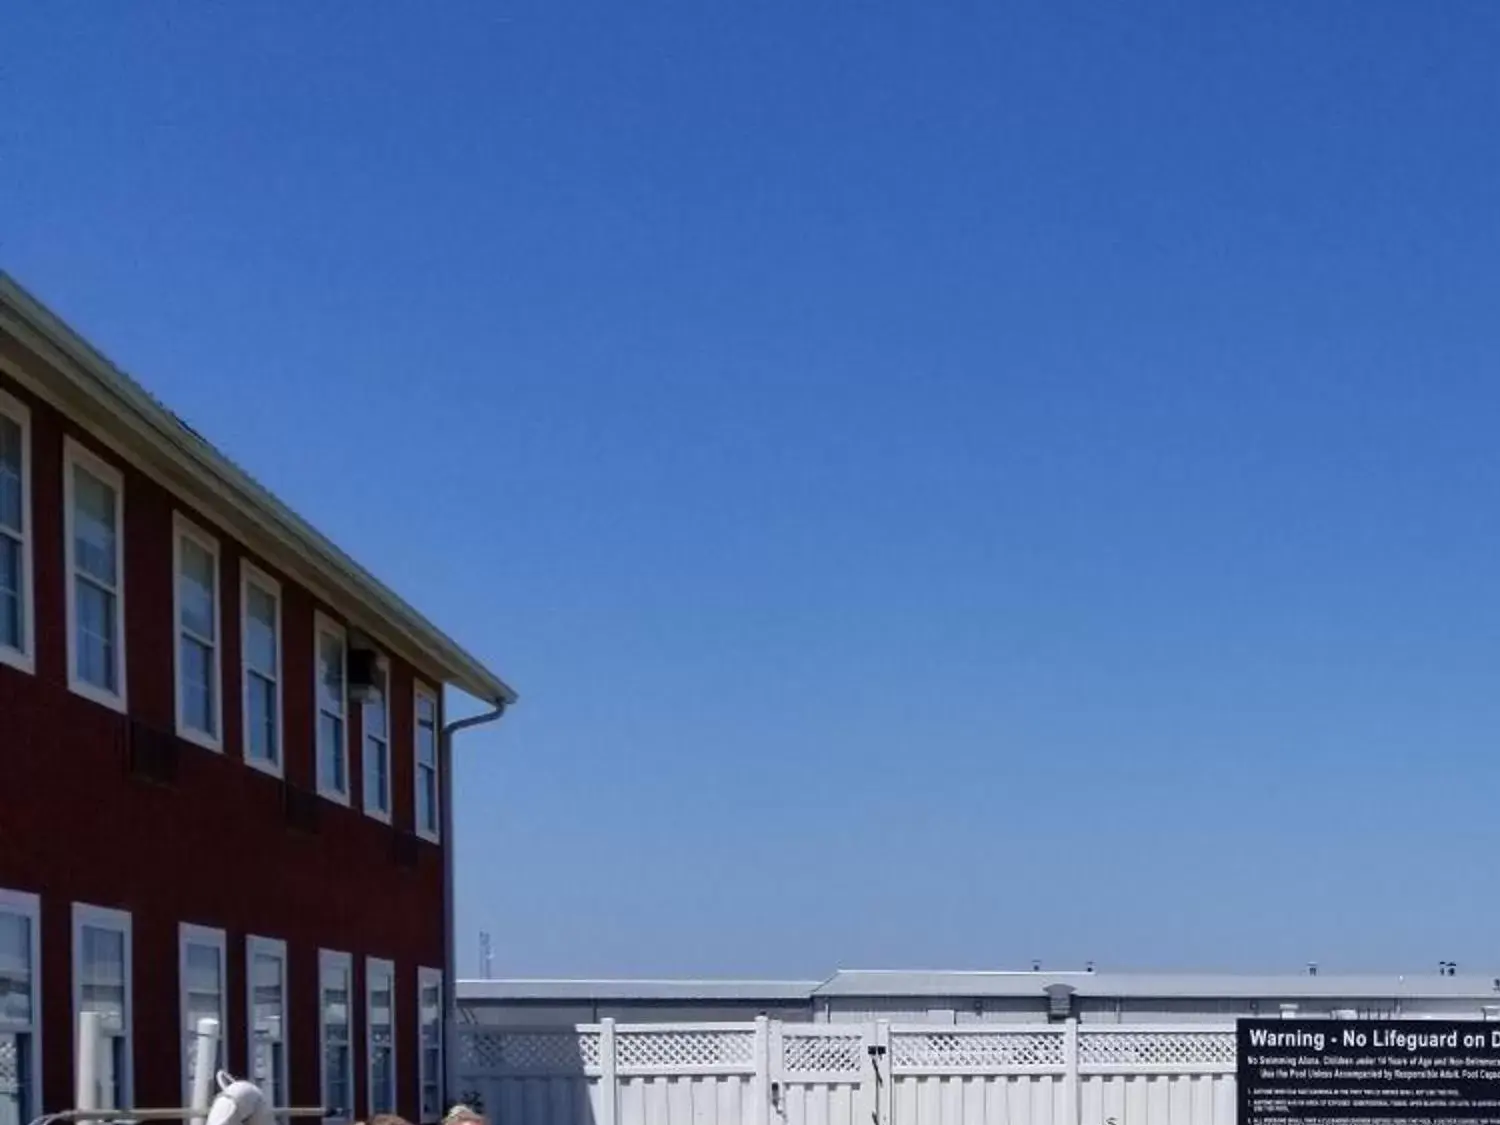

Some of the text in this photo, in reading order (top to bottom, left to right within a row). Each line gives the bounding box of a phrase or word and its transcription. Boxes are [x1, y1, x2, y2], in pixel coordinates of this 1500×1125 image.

[1249, 1028, 1325, 1051] Warning
[1343, 1029, 1367, 1047] No
[1373, 1029, 1457, 1051] Lifeguard
[1463, 1034, 1485, 1048] on
[1259, 1055, 1296, 1067] Swimming
[1289, 1068, 1306, 1079] Pool
[1334, 1068, 1382, 1081] Accompanied
[1383, 1068, 1393, 1081] by
[1462, 1069, 1478, 1079] Pool
